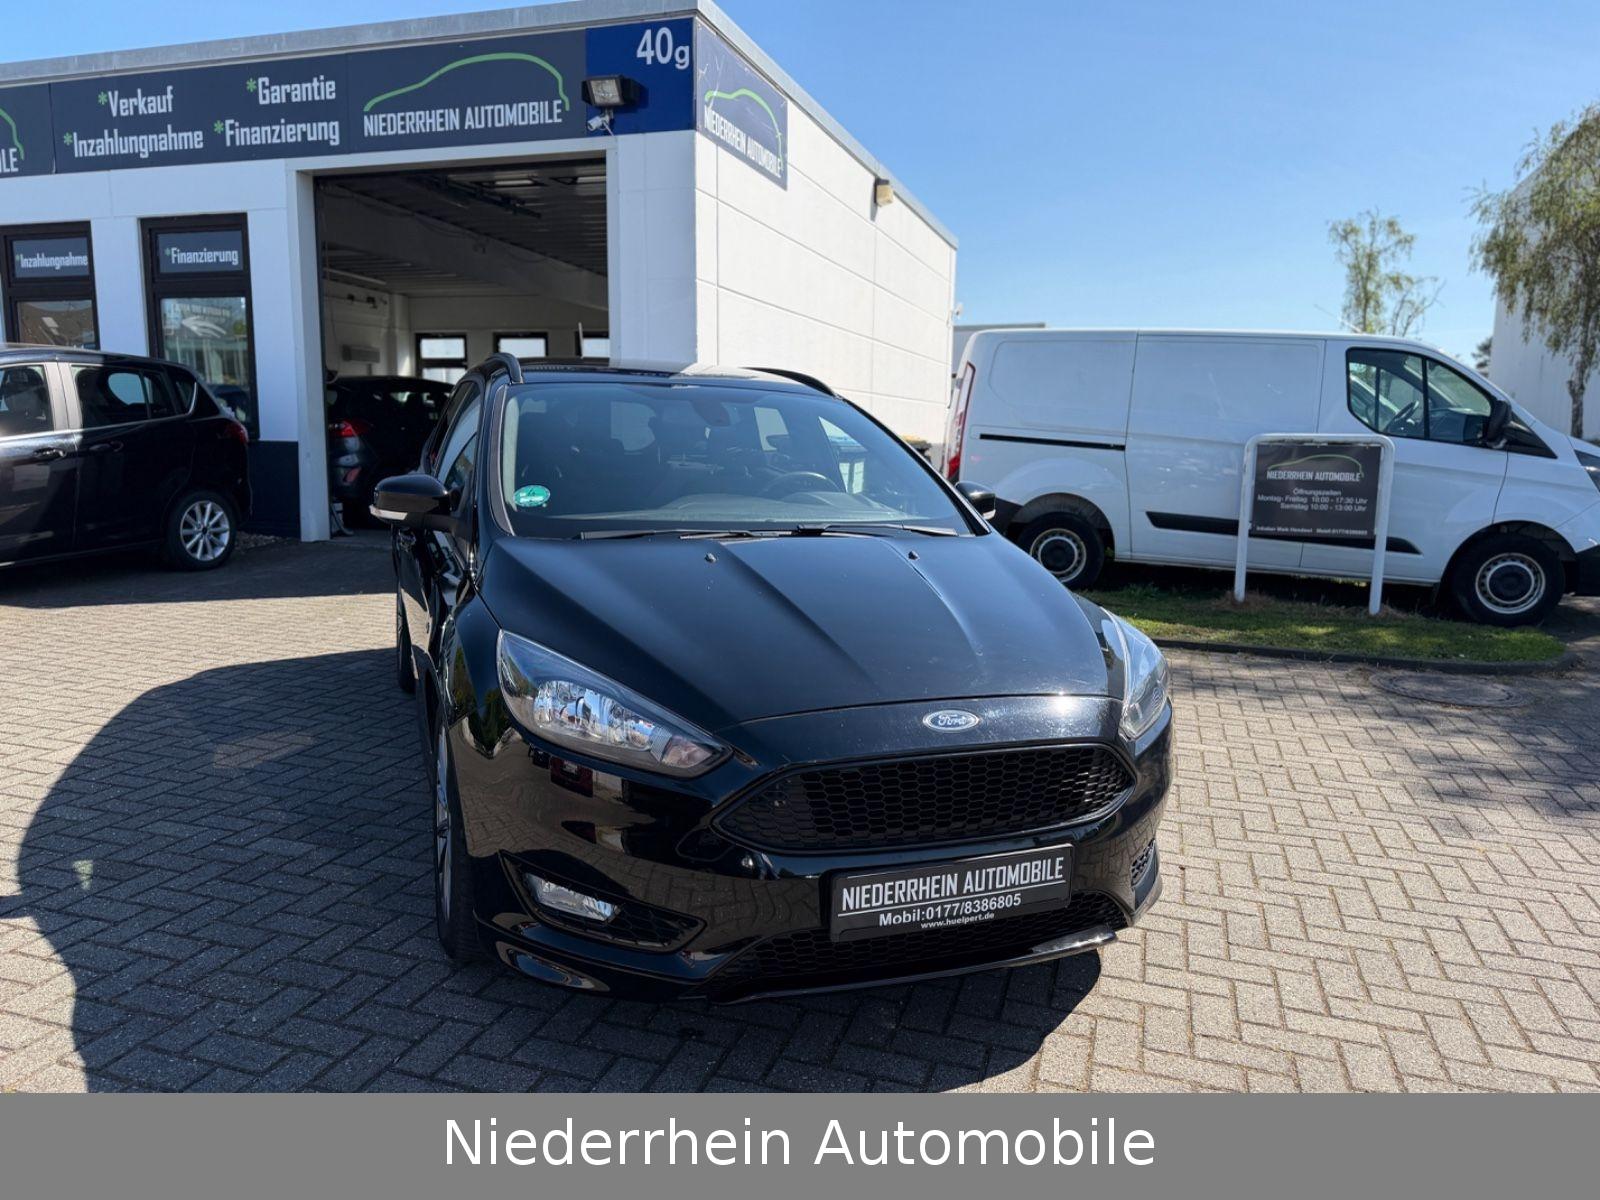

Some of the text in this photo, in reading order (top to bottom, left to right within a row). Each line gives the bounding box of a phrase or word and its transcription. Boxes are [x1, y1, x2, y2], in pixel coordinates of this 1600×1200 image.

[637, 27, 690, 70] 40g
[108, 85, 173, 117] Verkauf
[258, 75, 336, 105] Garantie
[225, 119, 340, 147] Finanzierung
[364, 100, 562, 137] NIEDERRHEIN AUTOMOBILE
[73, 124, 203, 158] Inzahlungnahme
[704, 104, 781, 178] NIEDERRHEIN AUTOMOBILE
[20, 252, 88, 270] Inzahlungnahme
[171, 247, 239, 265] Finanzierung
[1267, 470, 1360, 482] NIEDERRHEIN AUTOMOBILE
[842, 857, 1064, 911] NIEDERRHEIN AUTOMOBILE
[920, 912, 995, 929] www.huelpert.de
